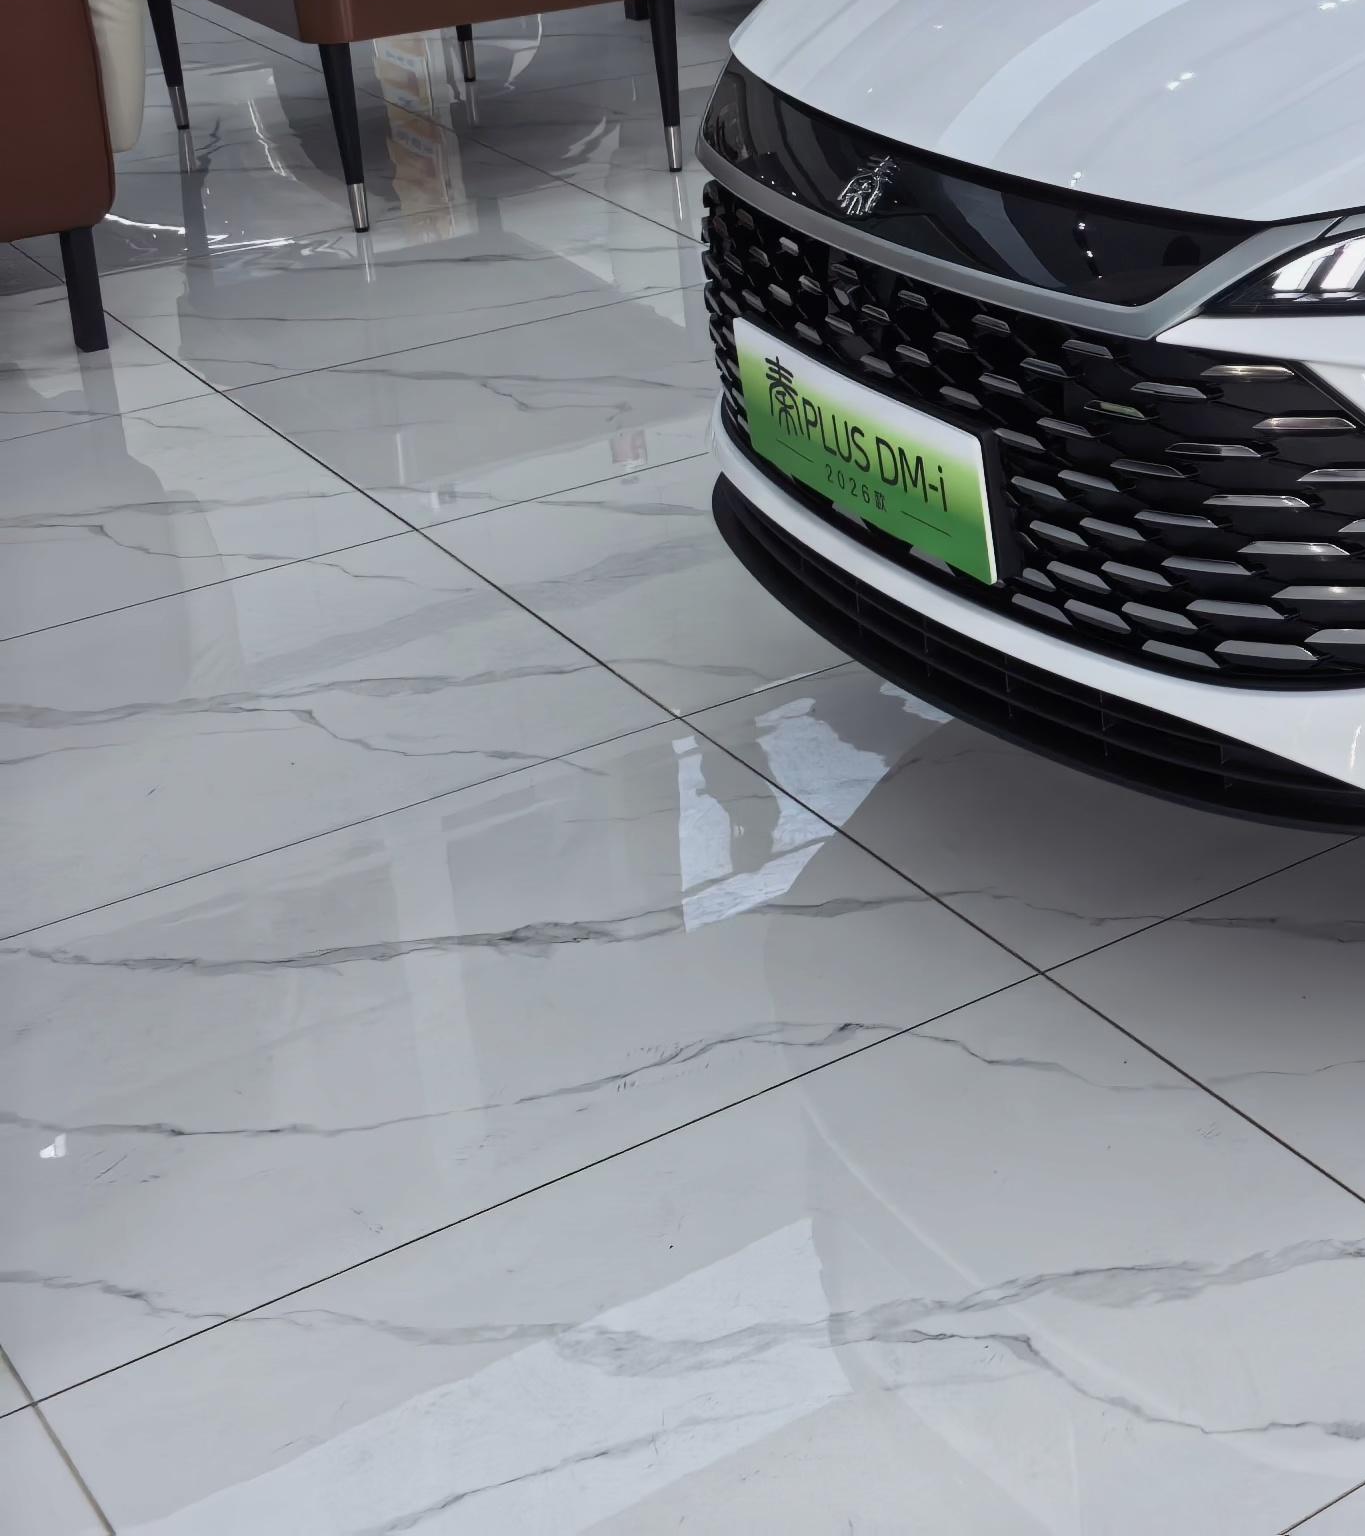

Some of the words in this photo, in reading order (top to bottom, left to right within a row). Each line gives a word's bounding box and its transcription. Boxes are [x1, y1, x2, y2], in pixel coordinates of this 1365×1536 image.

[764, 355, 872, 474] 秦PLUS
[875, 436, 949, 514] DM-i
[825, 463, 887, 514] 2026款
